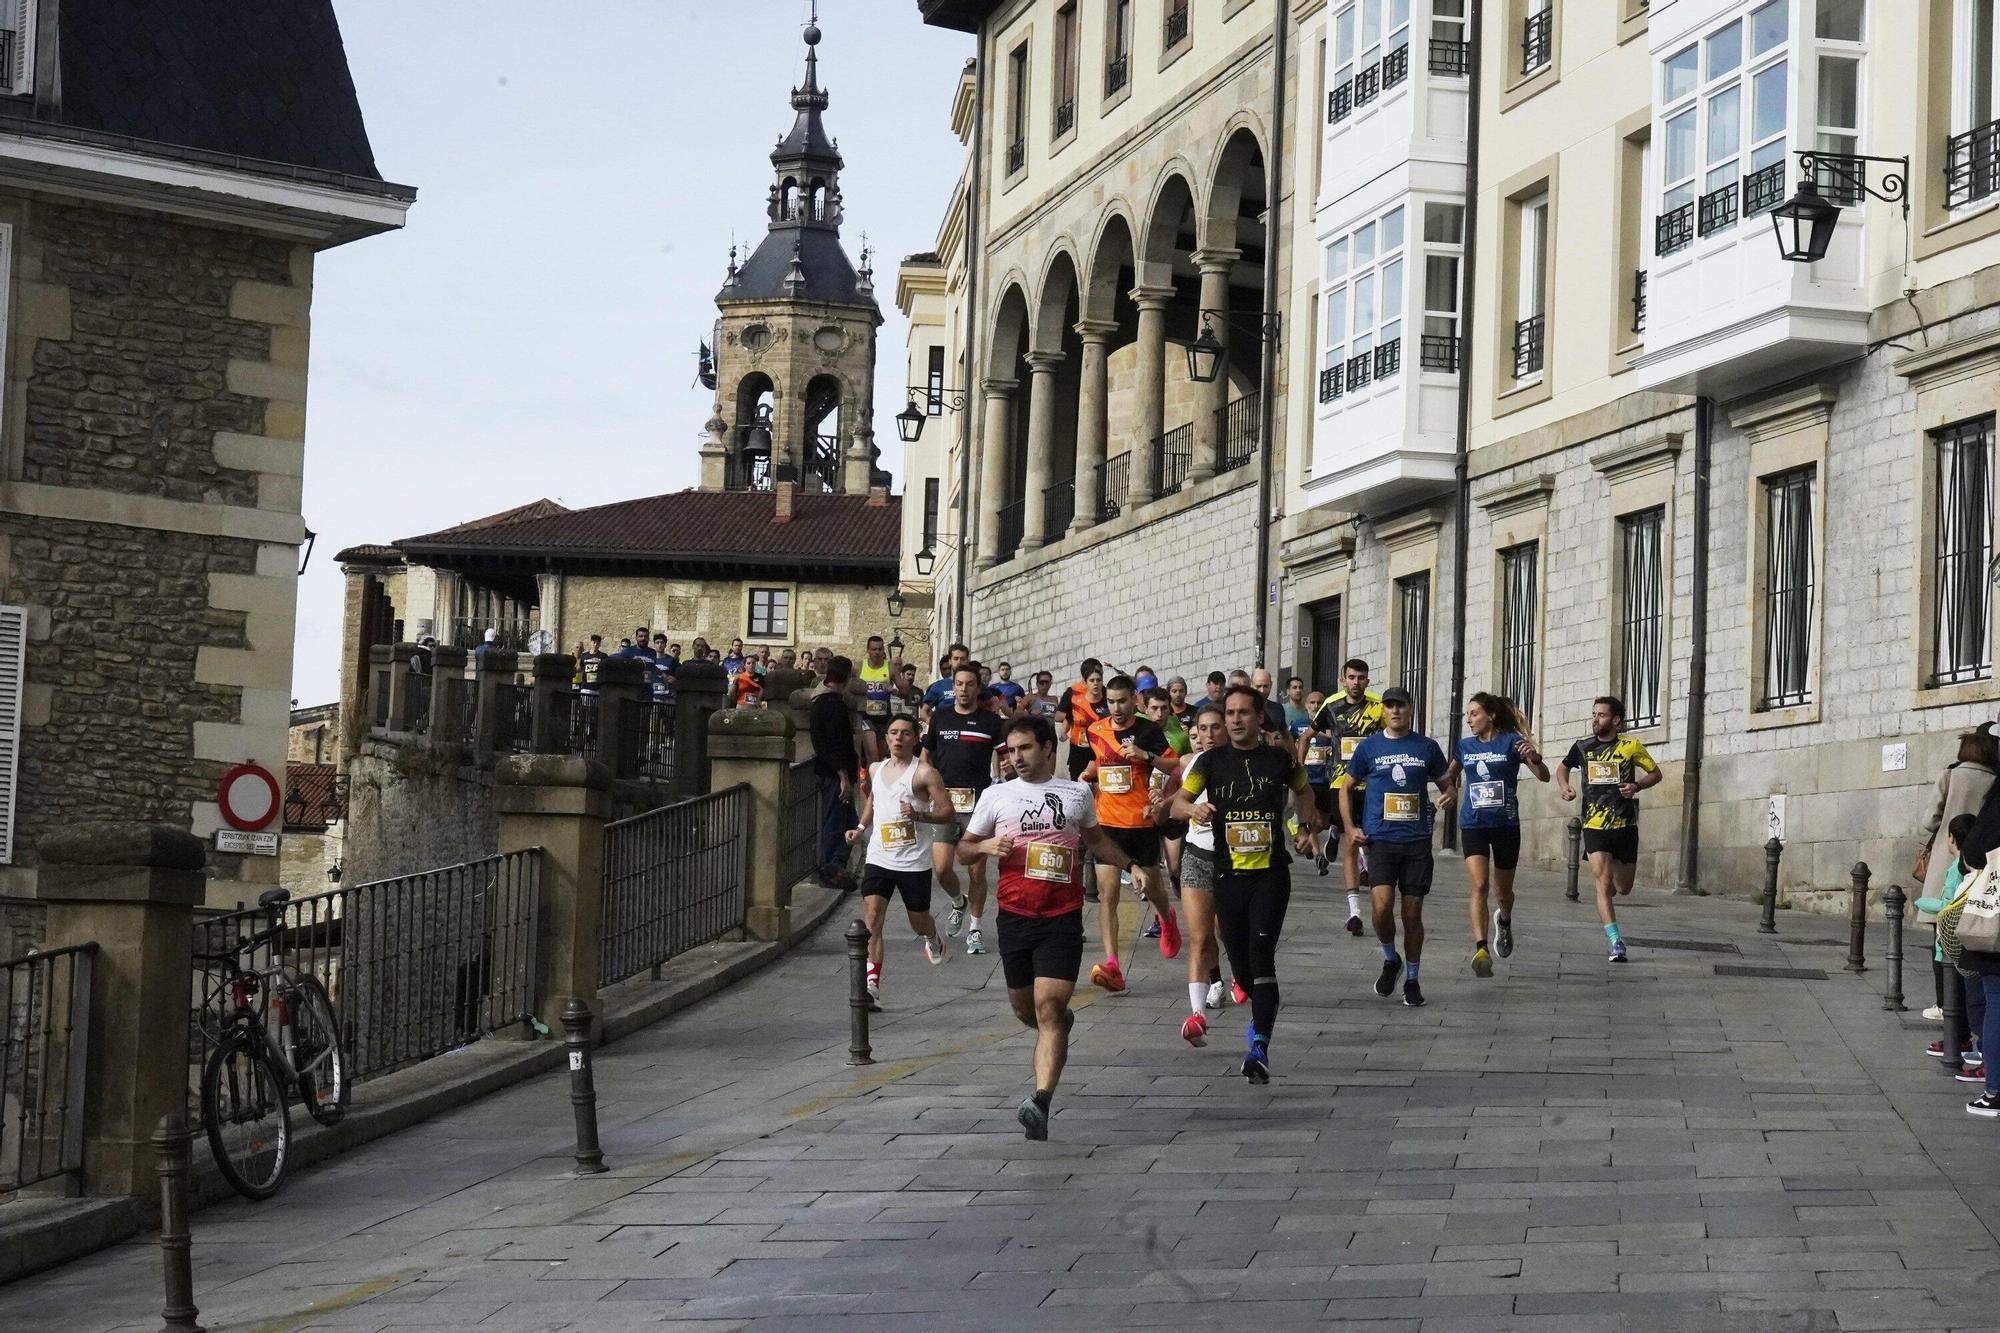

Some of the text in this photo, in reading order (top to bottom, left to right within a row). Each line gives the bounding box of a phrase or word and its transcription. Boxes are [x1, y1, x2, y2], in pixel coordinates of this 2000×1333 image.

[1595, 766, 1611, 776] 363
[1106, 772, 1123, 784] 463
[1478, 787, 1495, 798] 755
[1396, 800, 1411, 811] 113
[888, 826, 907, 839] 294
[1021, 821, 1051, 833] Galipa
[1237, 829, 1260, 843] 703
[1039, 852, 1063, 868] 650
